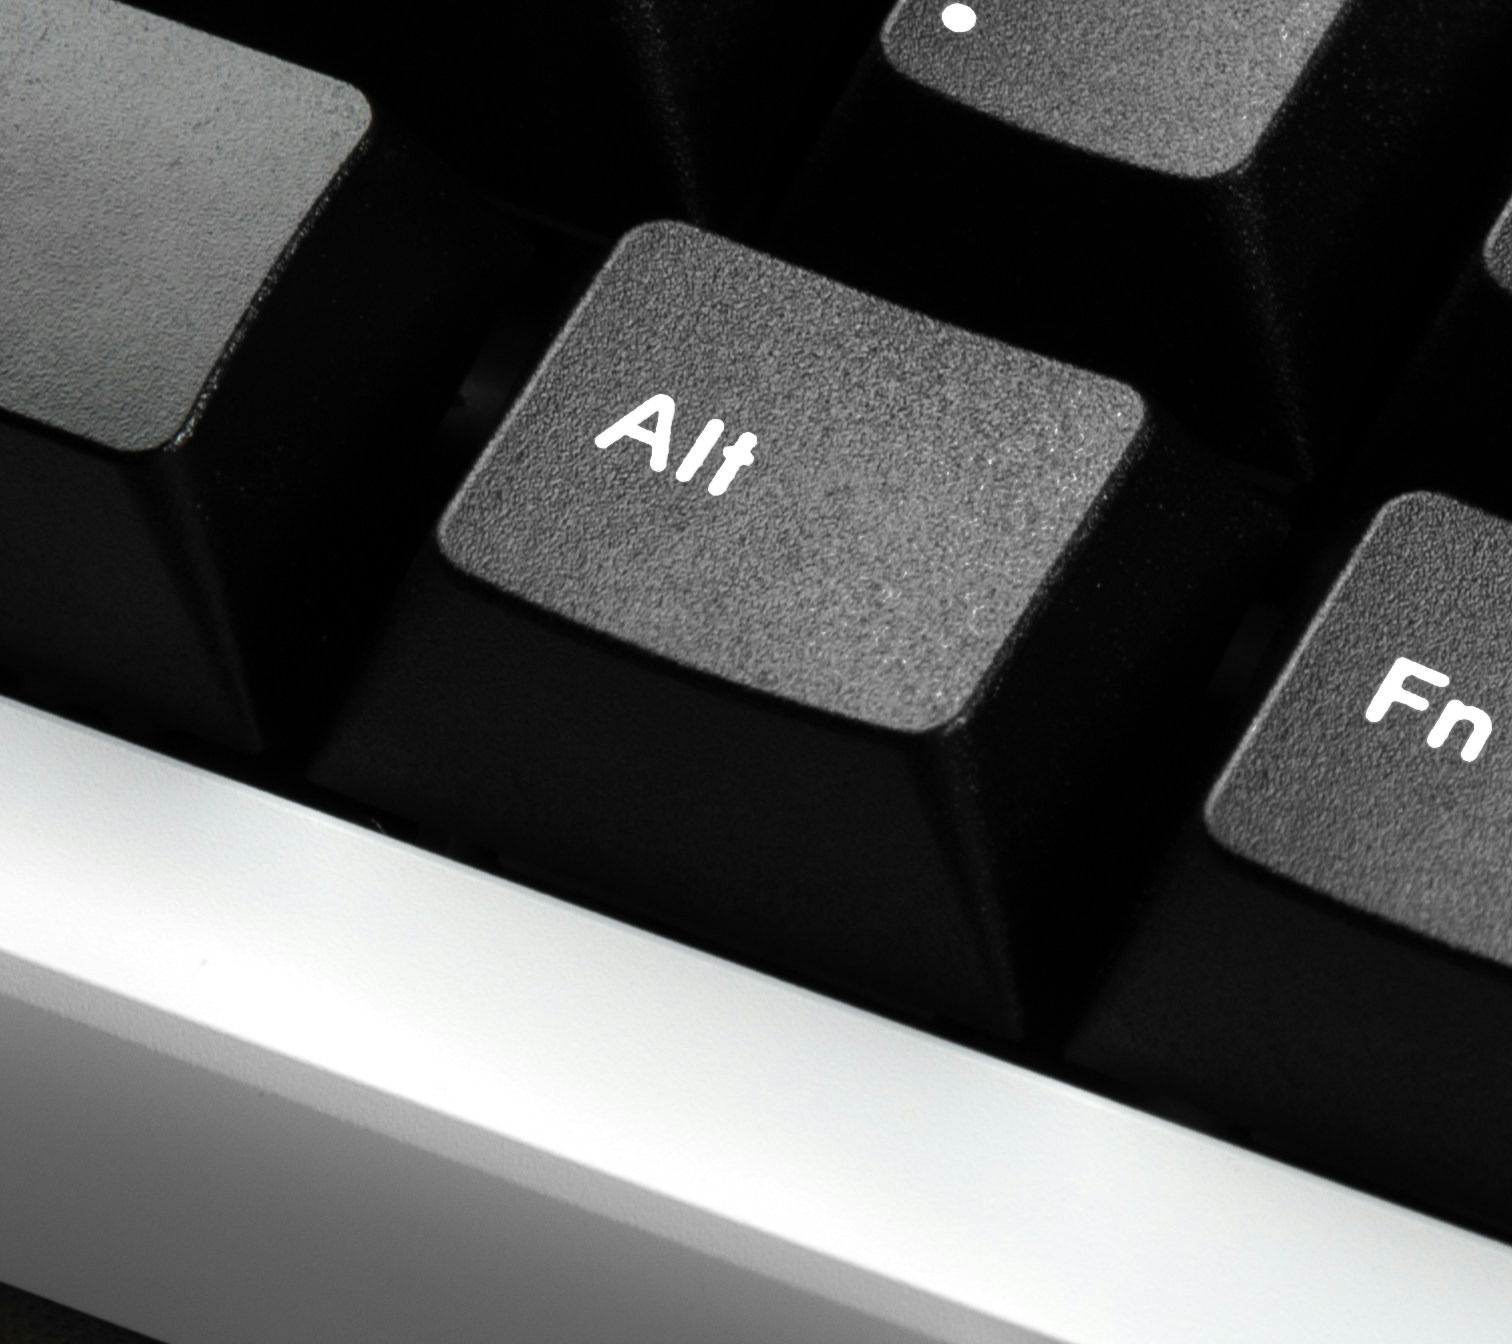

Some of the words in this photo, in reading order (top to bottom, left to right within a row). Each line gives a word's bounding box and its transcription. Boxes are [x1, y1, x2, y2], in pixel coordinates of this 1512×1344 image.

[939, 0, 979, 35] .
[592, 391, 760, 499] Alt
[1363, 655, 1495, 764] Fn
